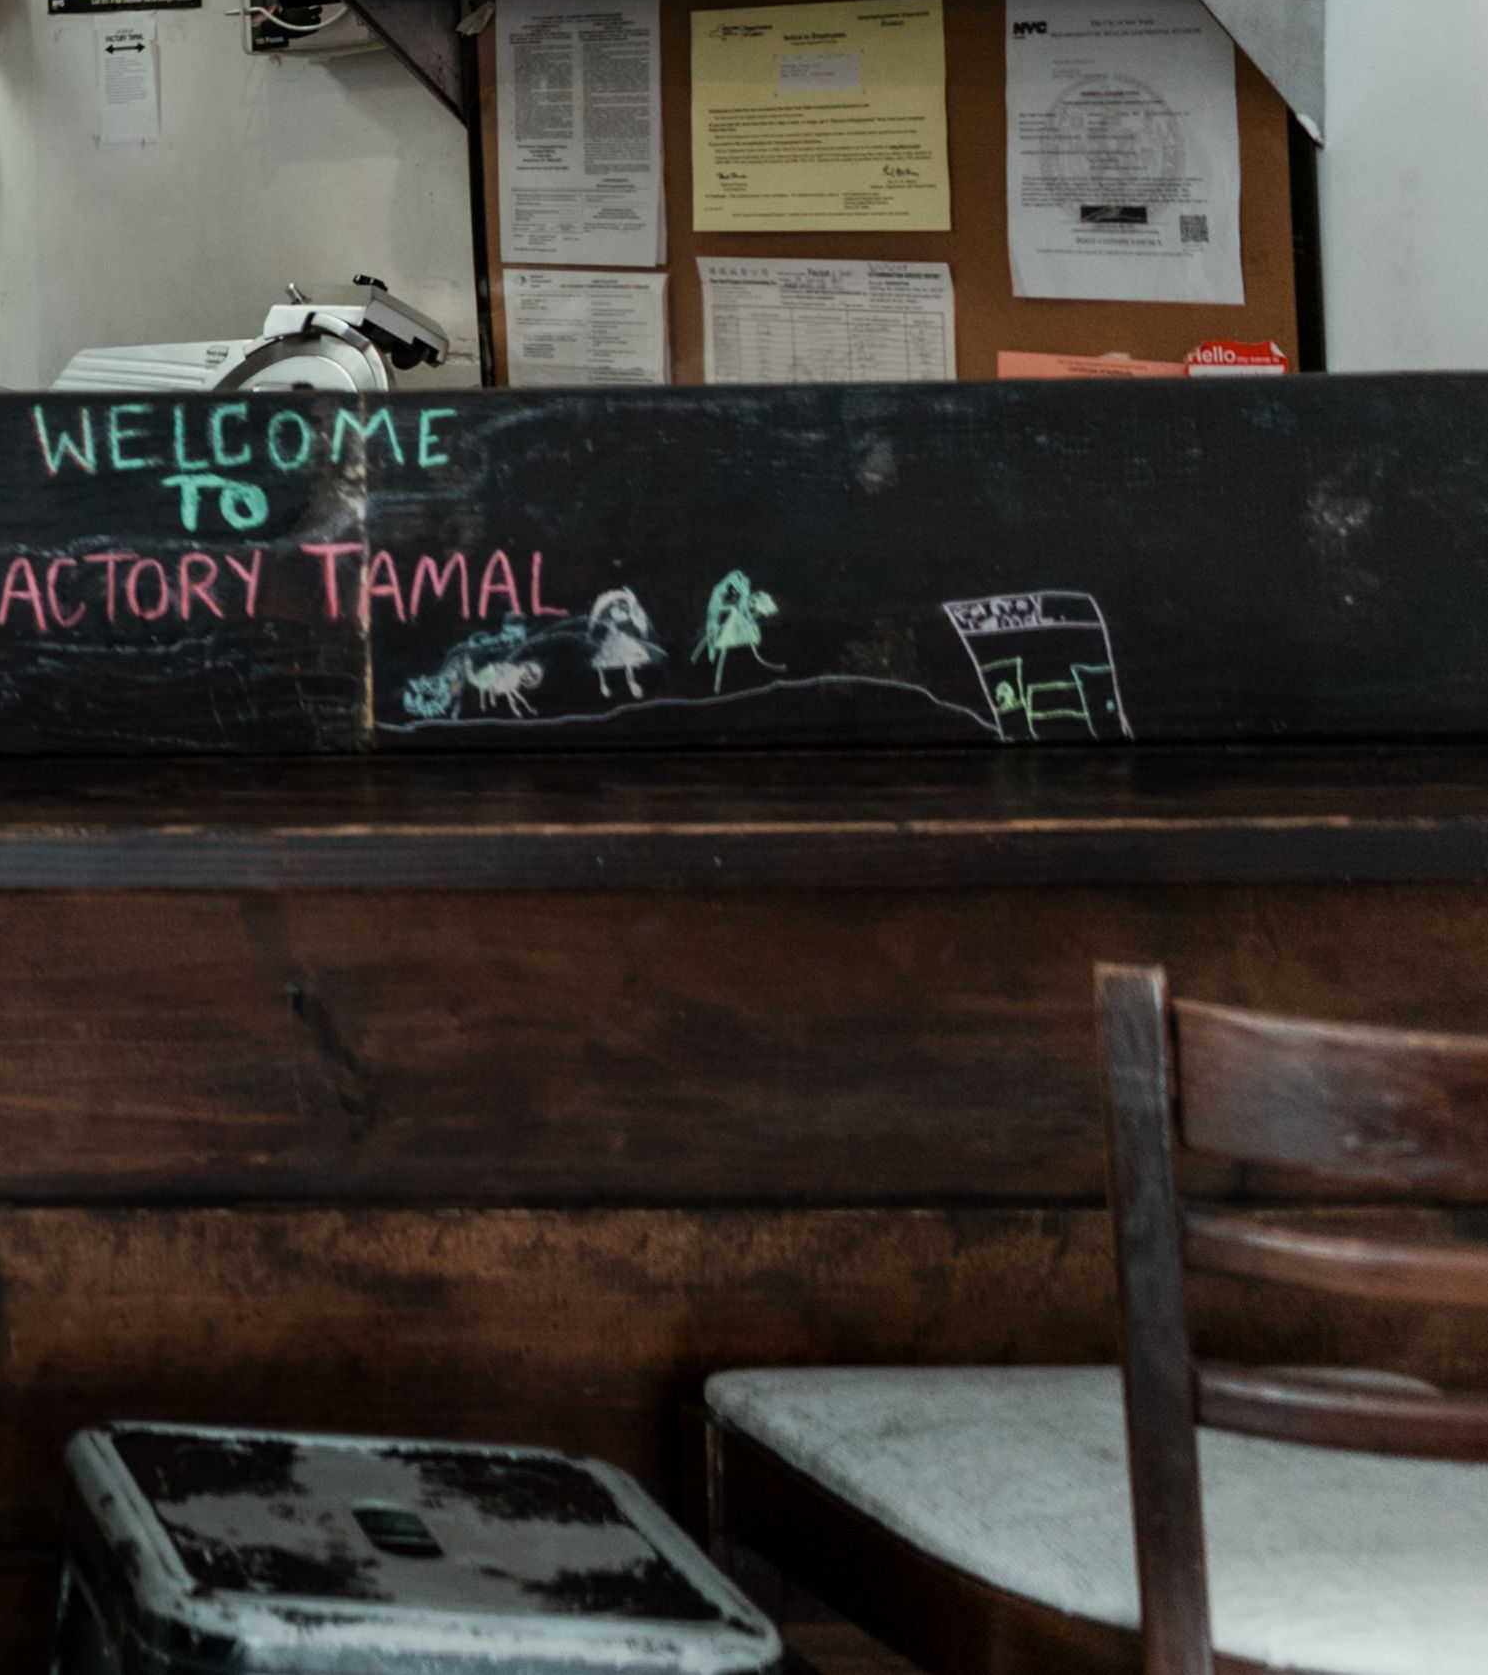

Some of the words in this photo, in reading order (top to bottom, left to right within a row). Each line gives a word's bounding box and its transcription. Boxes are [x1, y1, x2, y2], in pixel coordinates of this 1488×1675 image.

[33, 403, 457, 477] WELCOME
[162, 474, 268, 531] TO
[300, 542, 569, 621] TAMAL
